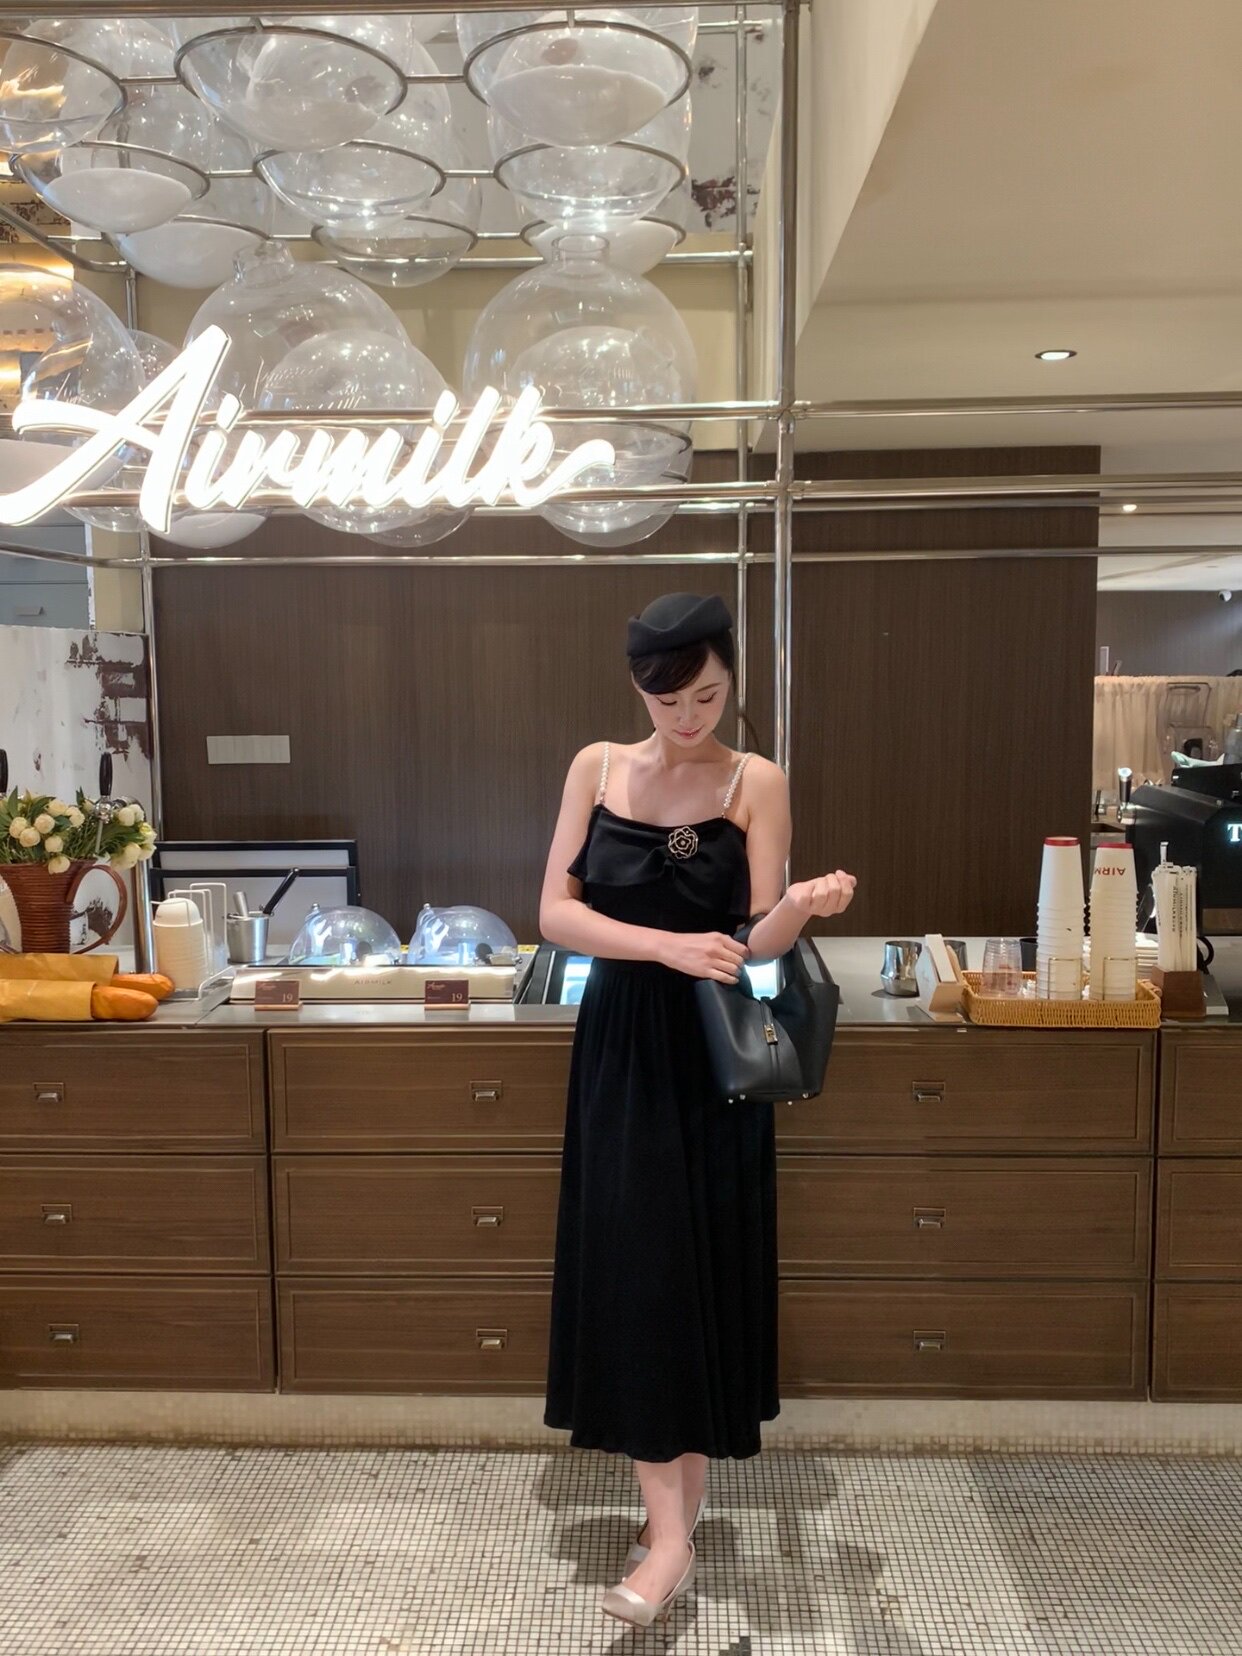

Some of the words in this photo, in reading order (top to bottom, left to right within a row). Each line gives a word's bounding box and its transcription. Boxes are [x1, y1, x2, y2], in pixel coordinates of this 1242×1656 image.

[0, 323, 616, 534] Airmilk
[282, 992, 293, 1003] 19
[451, 992, 463, 1002] 19
